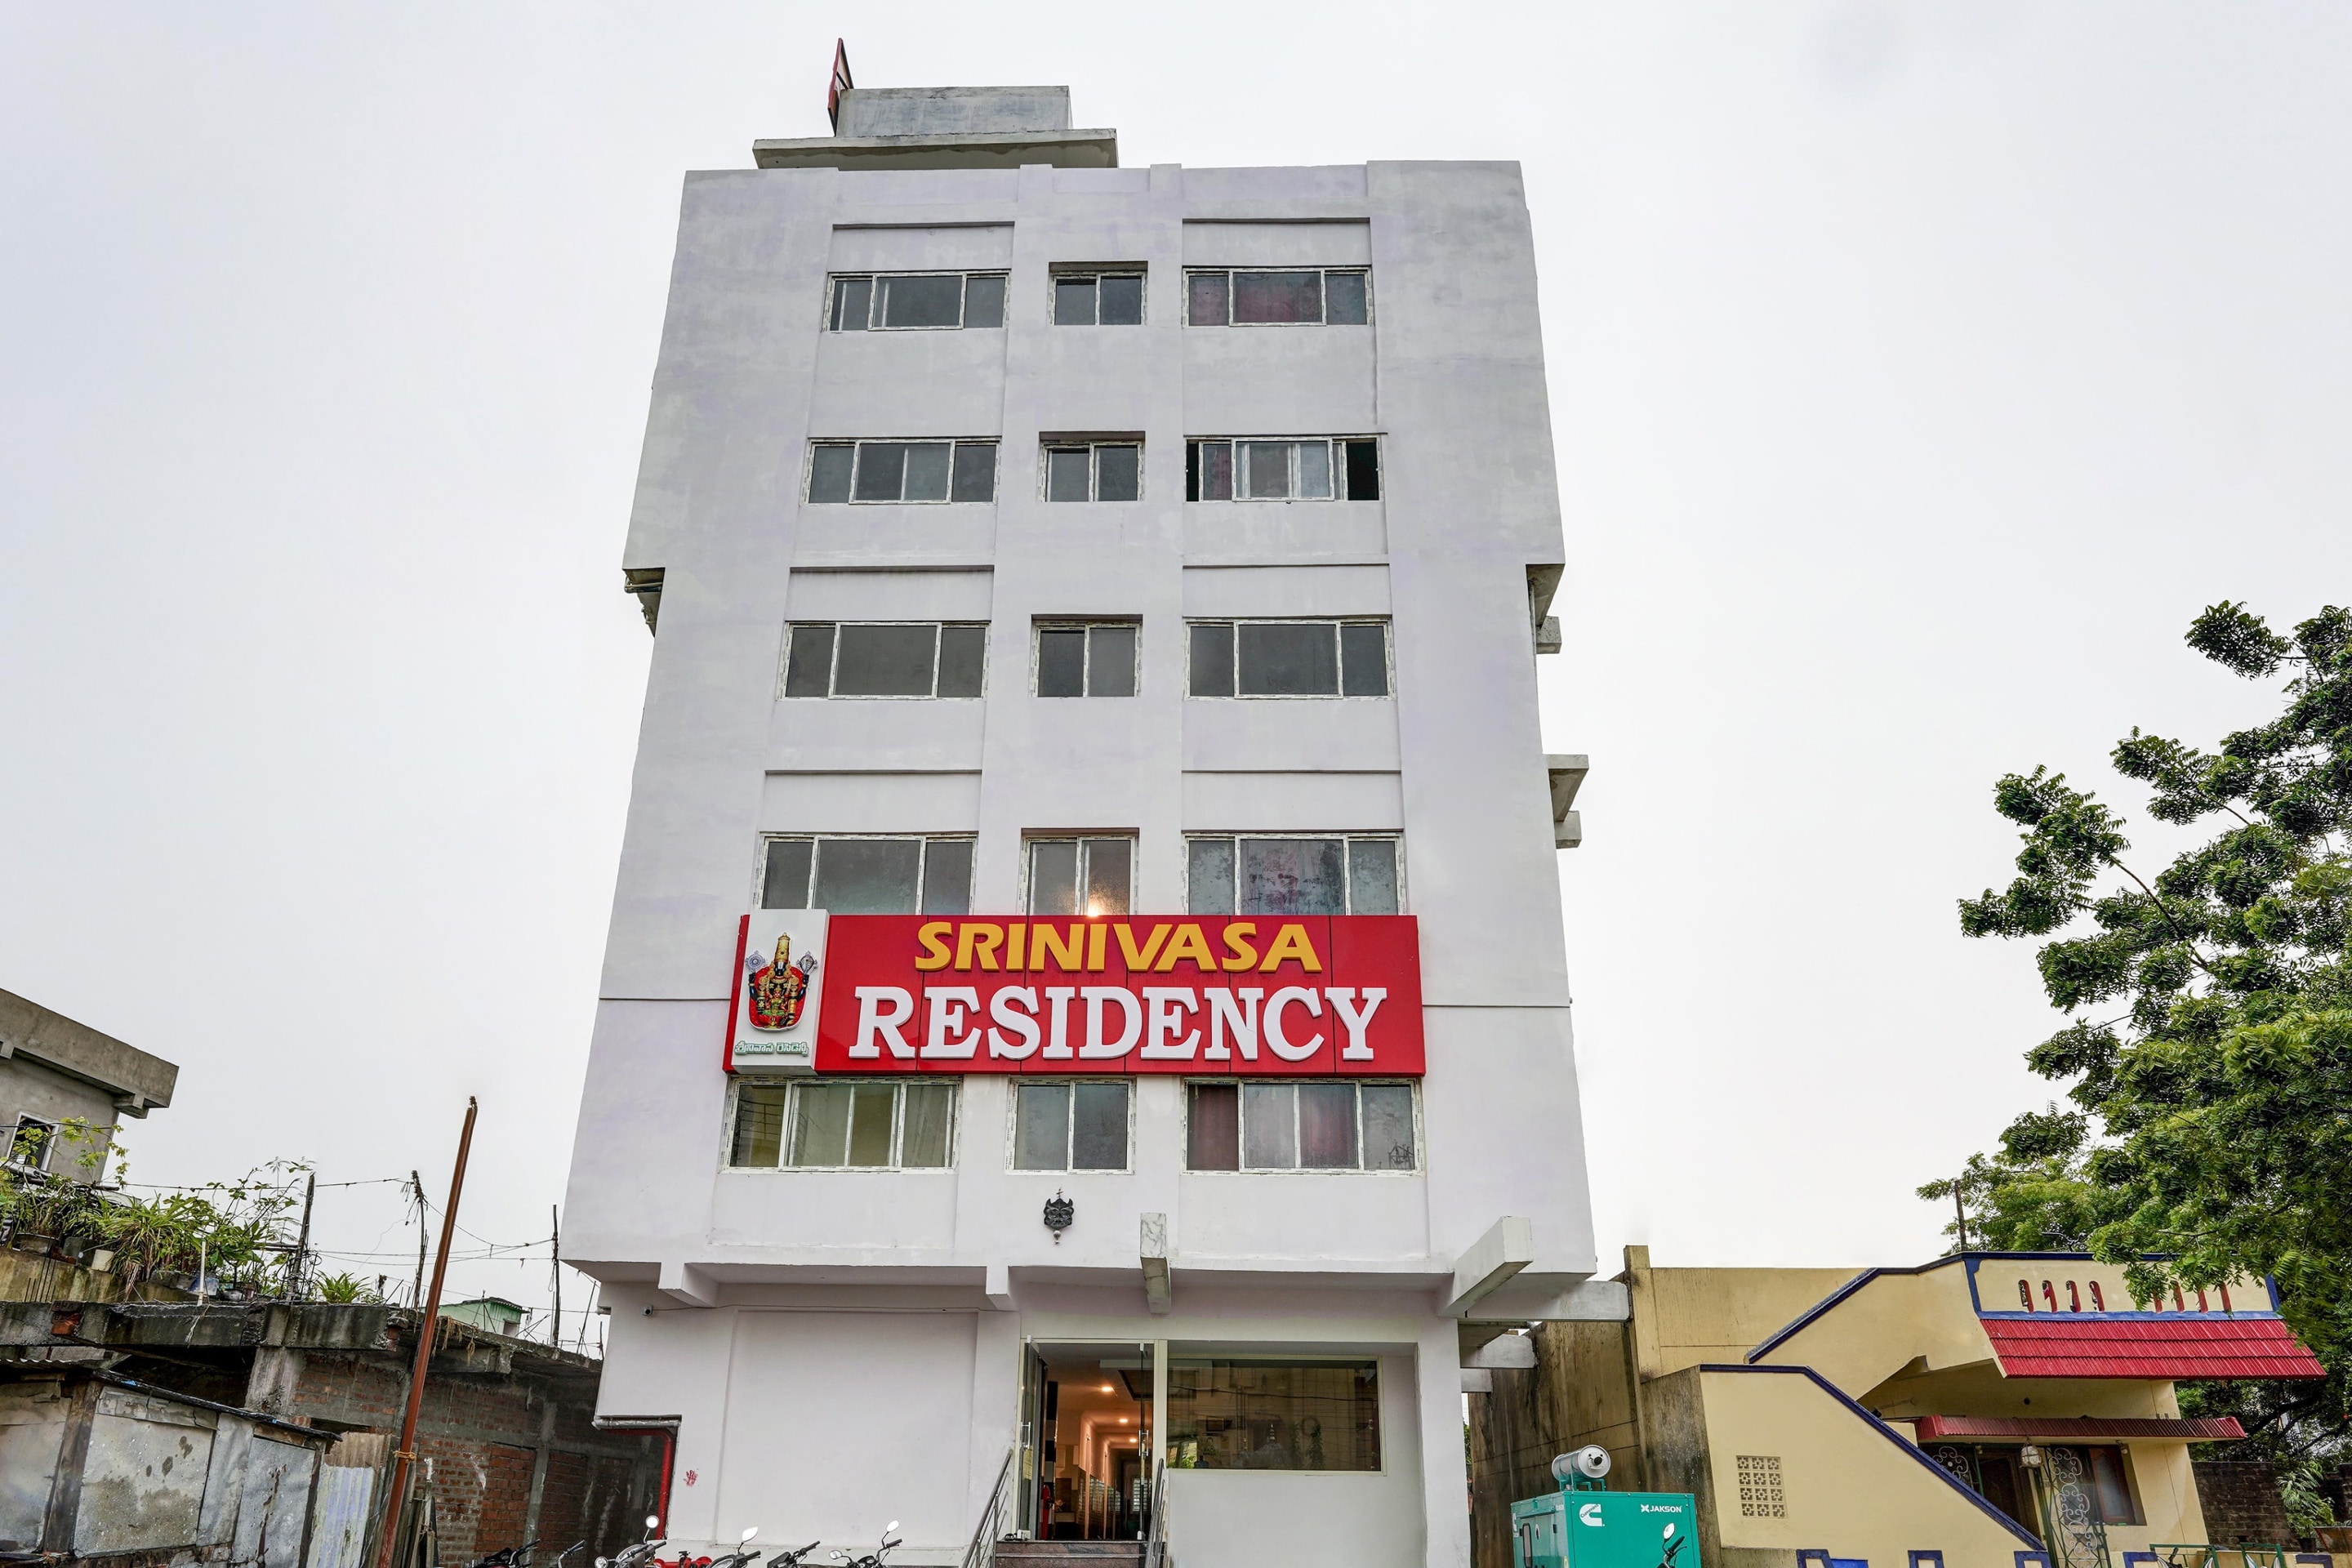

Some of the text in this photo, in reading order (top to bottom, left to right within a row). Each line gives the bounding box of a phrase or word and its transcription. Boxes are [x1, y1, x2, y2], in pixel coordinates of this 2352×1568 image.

[915, 922, 1321, 973] SRINIVASA
[849, 986, 1387, 1061] RESIDENCY
[1650, 1505, 1682, 1513] JAKSON
